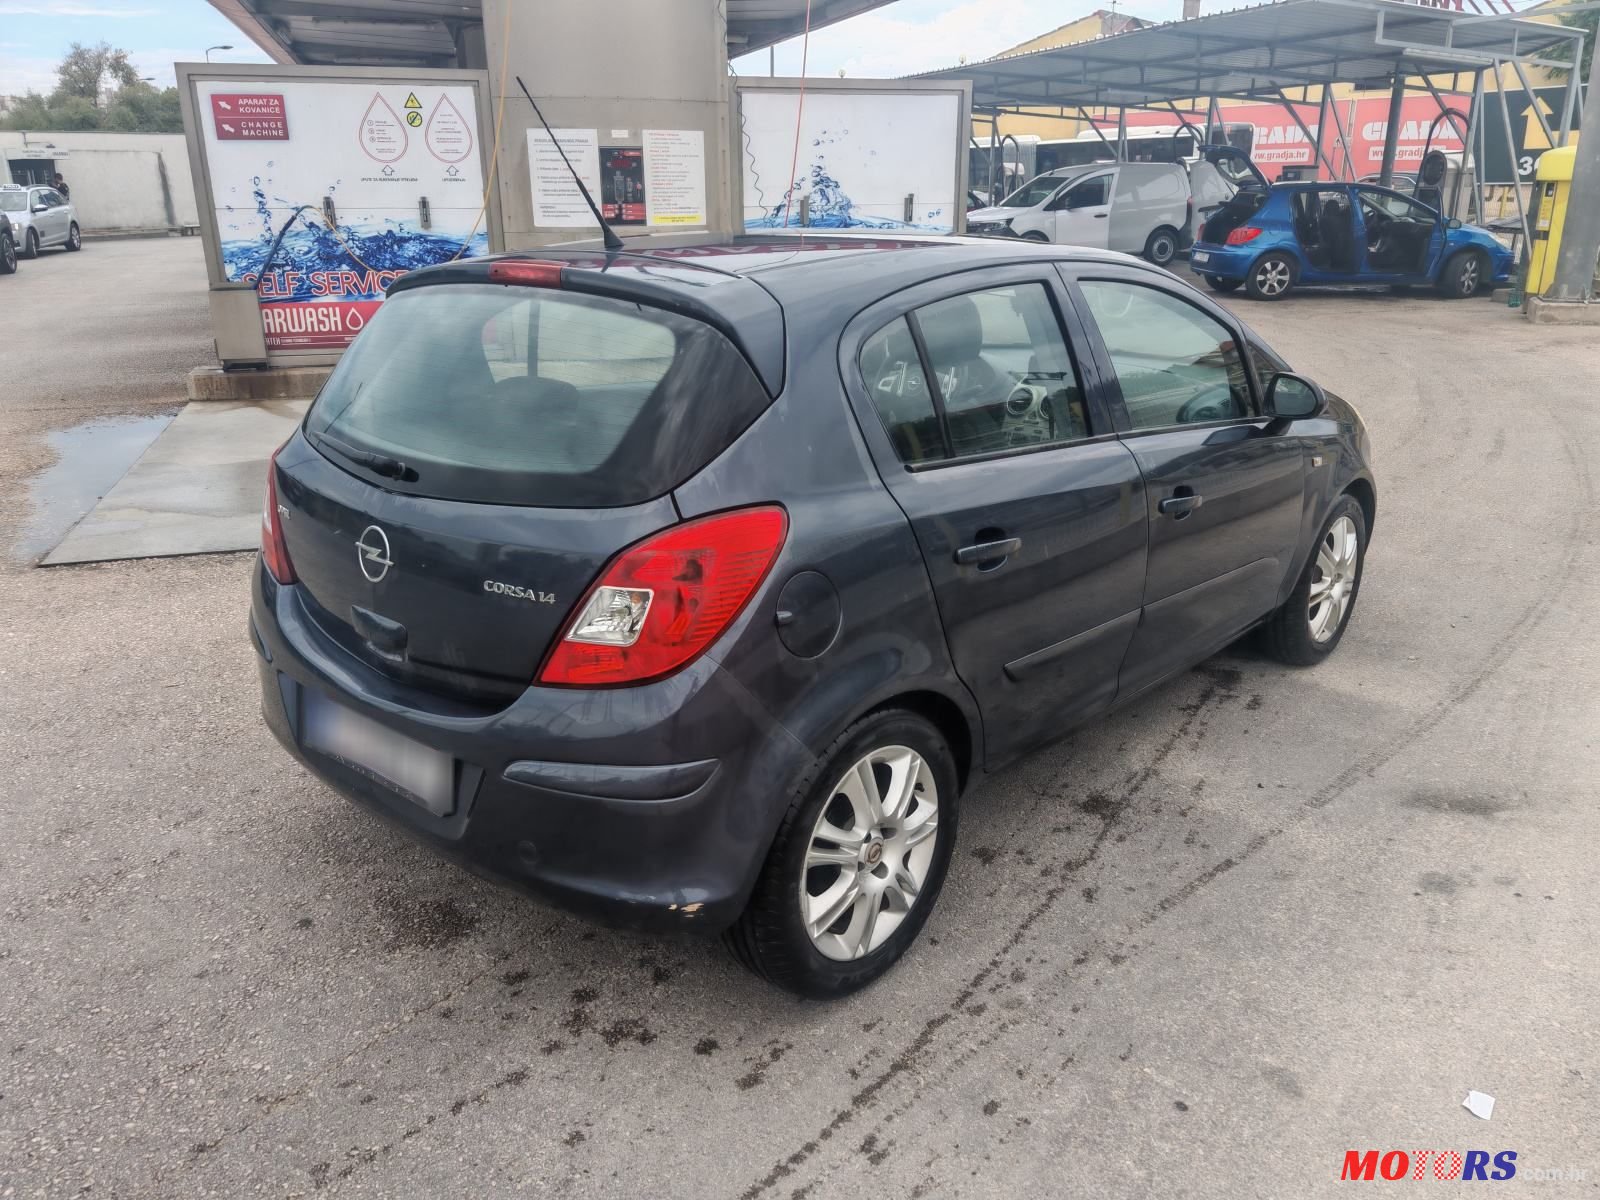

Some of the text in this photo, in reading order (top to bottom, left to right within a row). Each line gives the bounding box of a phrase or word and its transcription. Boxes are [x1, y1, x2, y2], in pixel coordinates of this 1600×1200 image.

[269, 98, 280, 106] ZA
[239, 106, 281, 114] KOVANICE
[242, 129, 284, 137] MACHINE
[310, 270, 408, 296] SERVIC
[261, 307, 343, 334] ARWASH
[483, 580, 536, 601] CORSA
